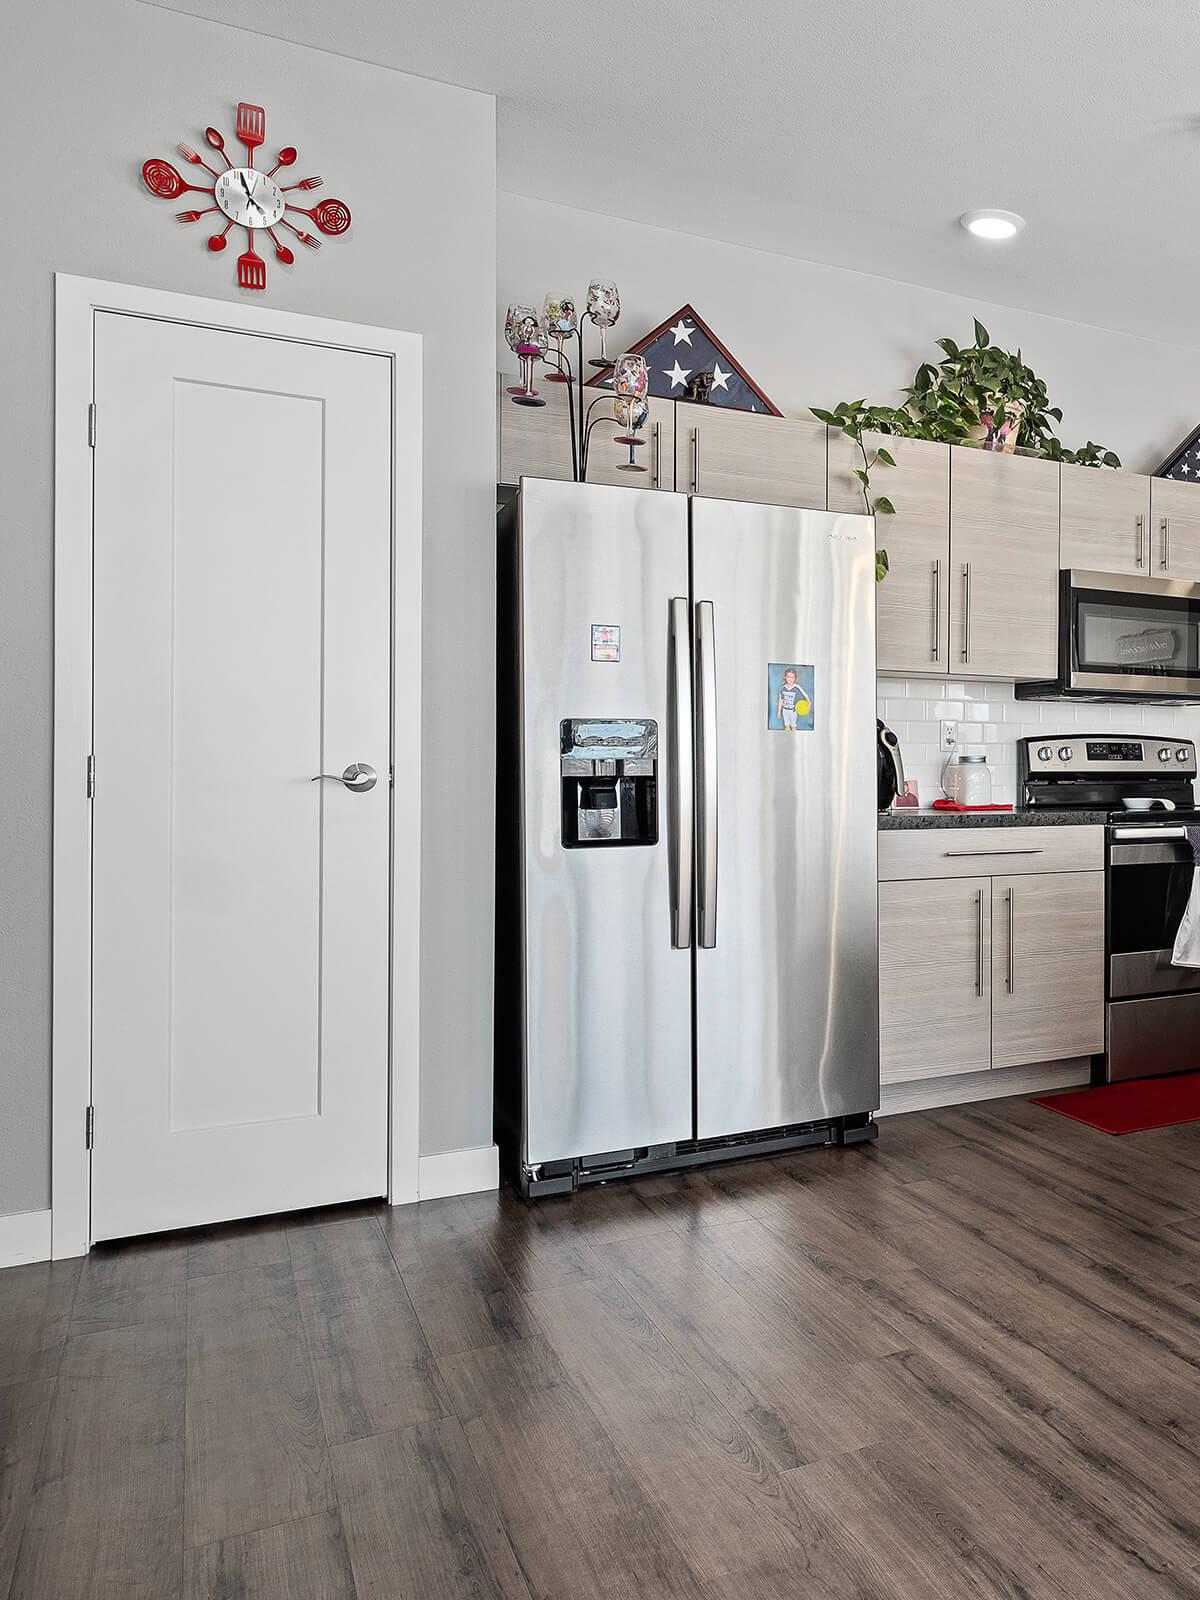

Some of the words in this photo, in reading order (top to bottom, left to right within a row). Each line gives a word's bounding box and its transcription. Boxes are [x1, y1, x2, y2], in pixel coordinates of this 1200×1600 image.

[234, 171, 239, 180] 11
[248, 170, 254, 180] 12
[223, 177, 229, 186] 10
[220, 188, 224, 197] 9
[272, 187, 276, 196] 2
[224, 200, 228, 209] 8
[277, 199, 281, 208] 3
[236, 211, 239, 220] 7
[273, 210, 276, 218] 4
[249, 216, 253, 226] 6
[263, 216, 267, 225] 5
